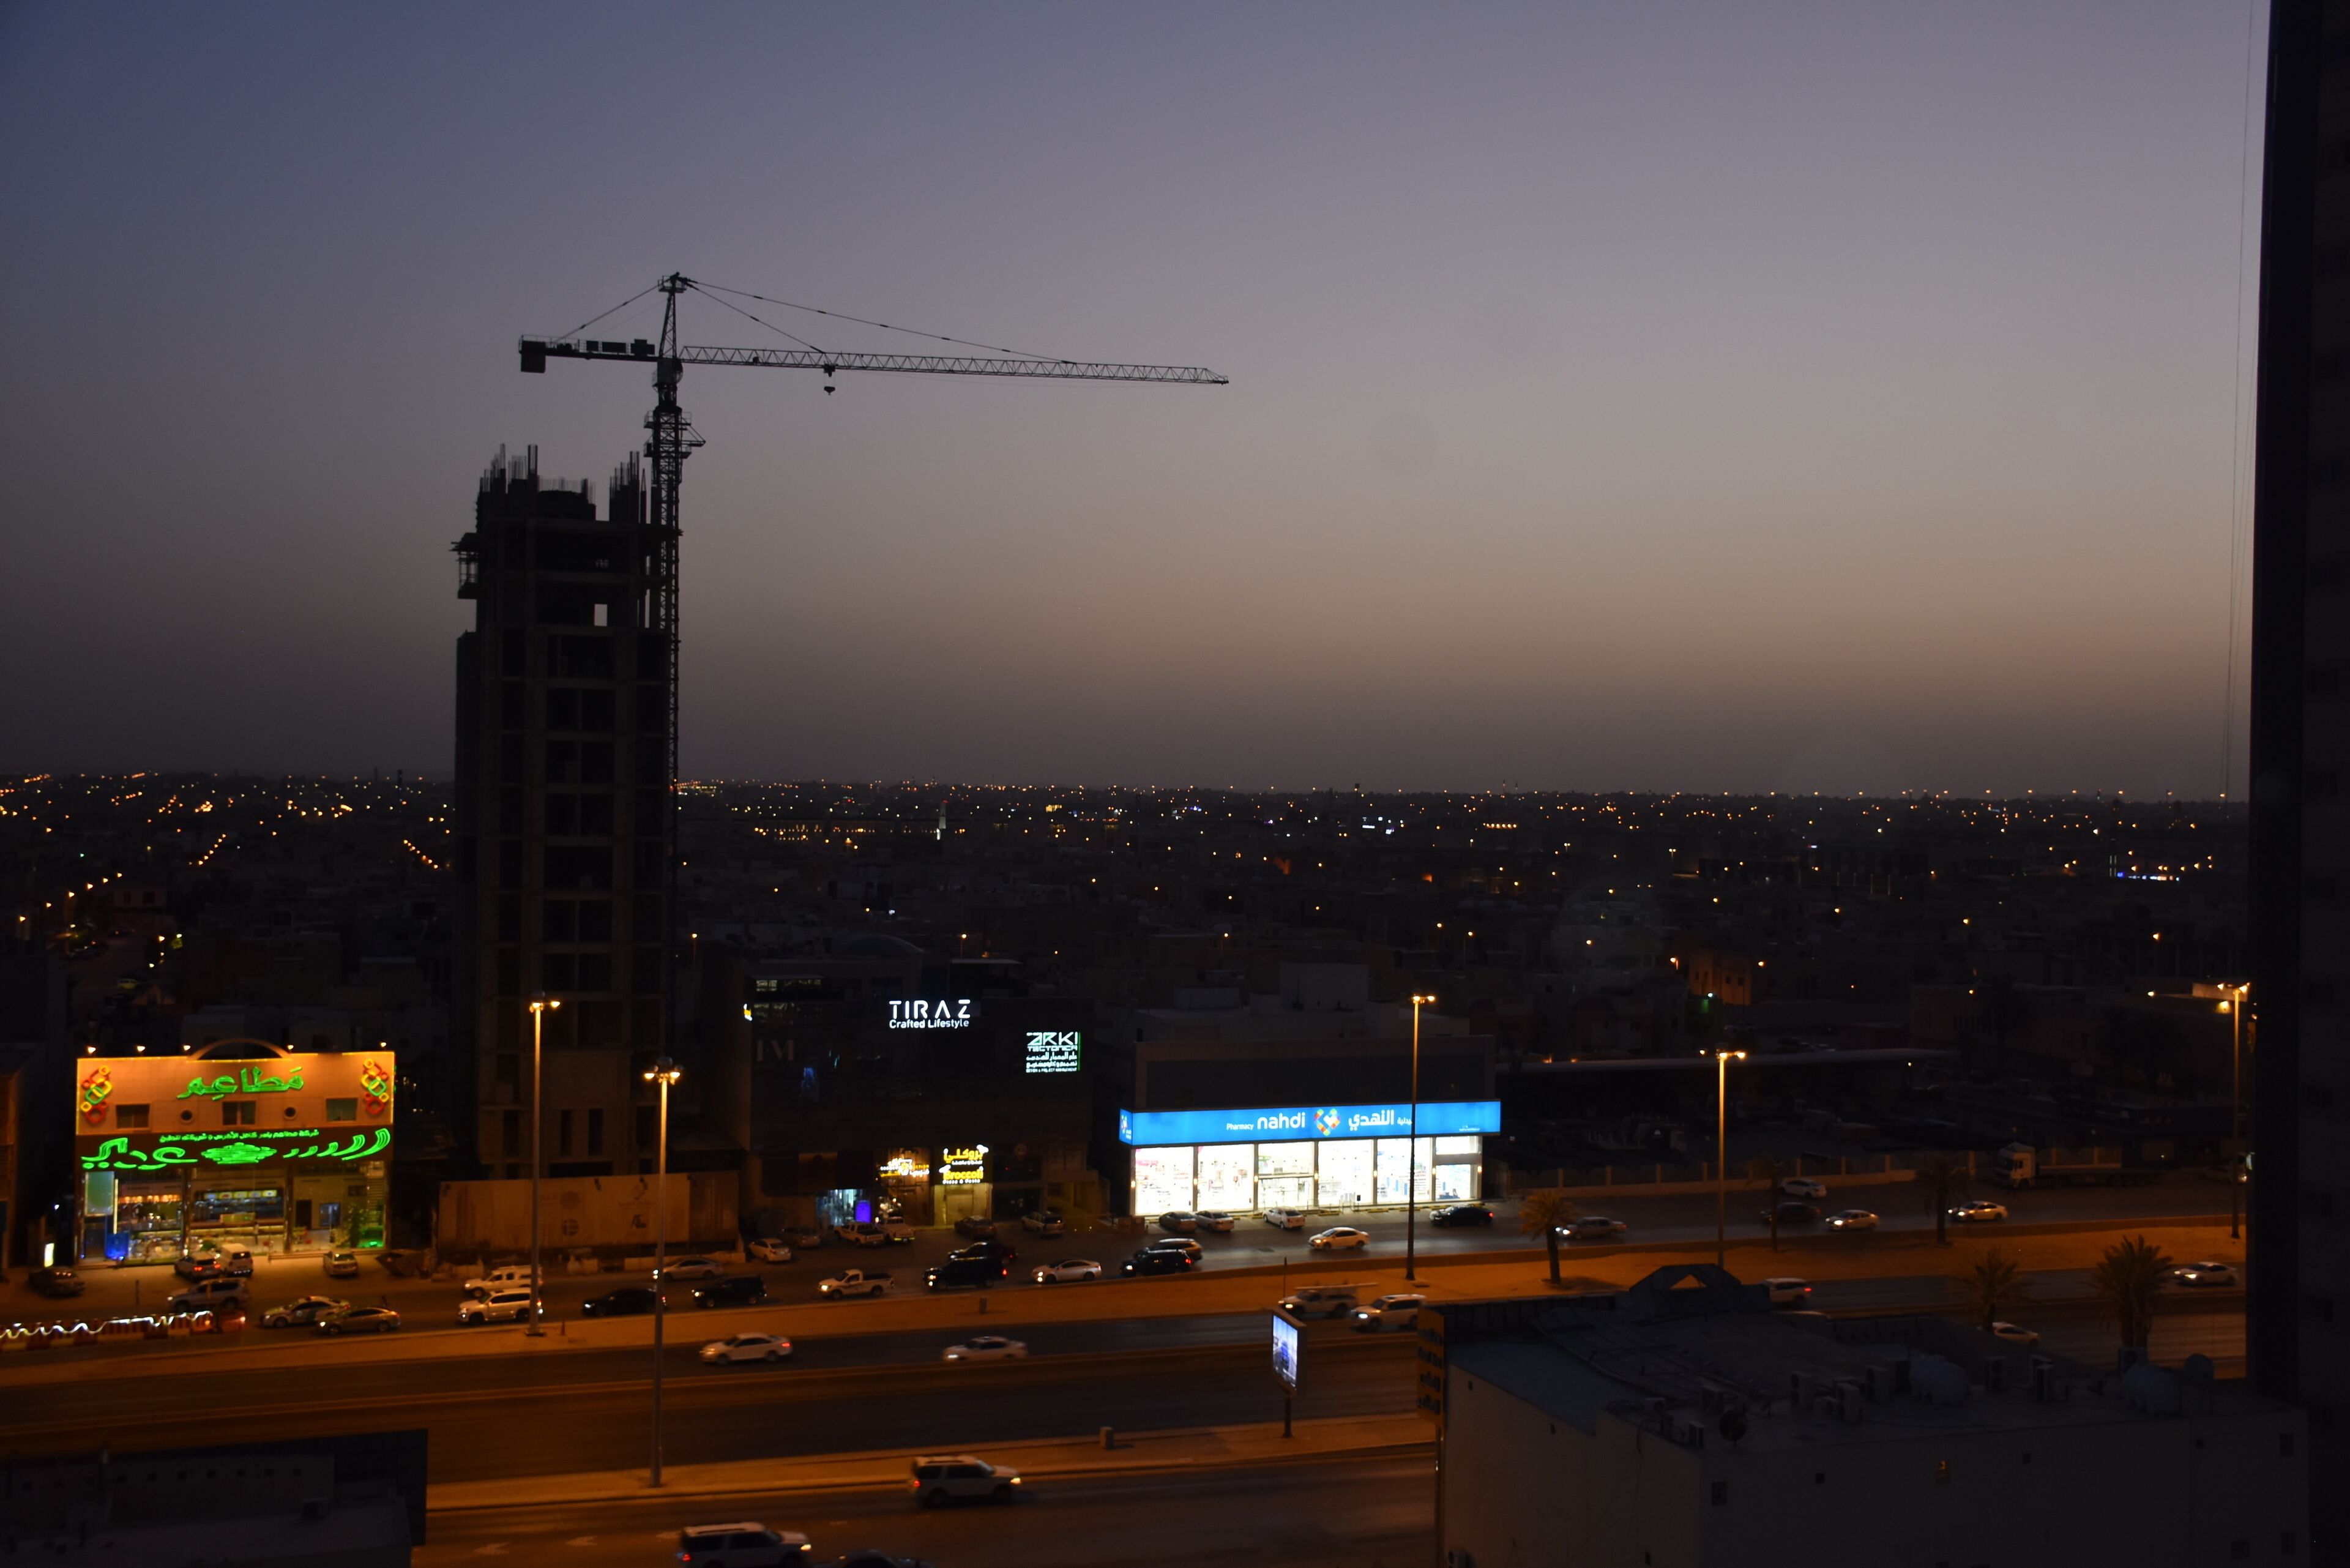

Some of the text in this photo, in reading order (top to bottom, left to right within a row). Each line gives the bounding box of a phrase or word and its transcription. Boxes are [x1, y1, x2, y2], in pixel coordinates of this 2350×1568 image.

[889, 999, 971, 1019] TIRAZ
[889, 1018, 969, 1029] Crafted Lifestyle
[1258, 1112, 1305, 1129] nahdi
[1348, 1110, 1394, 1131] النهدي
[942, 1167, 983, 1180] Broccoli
